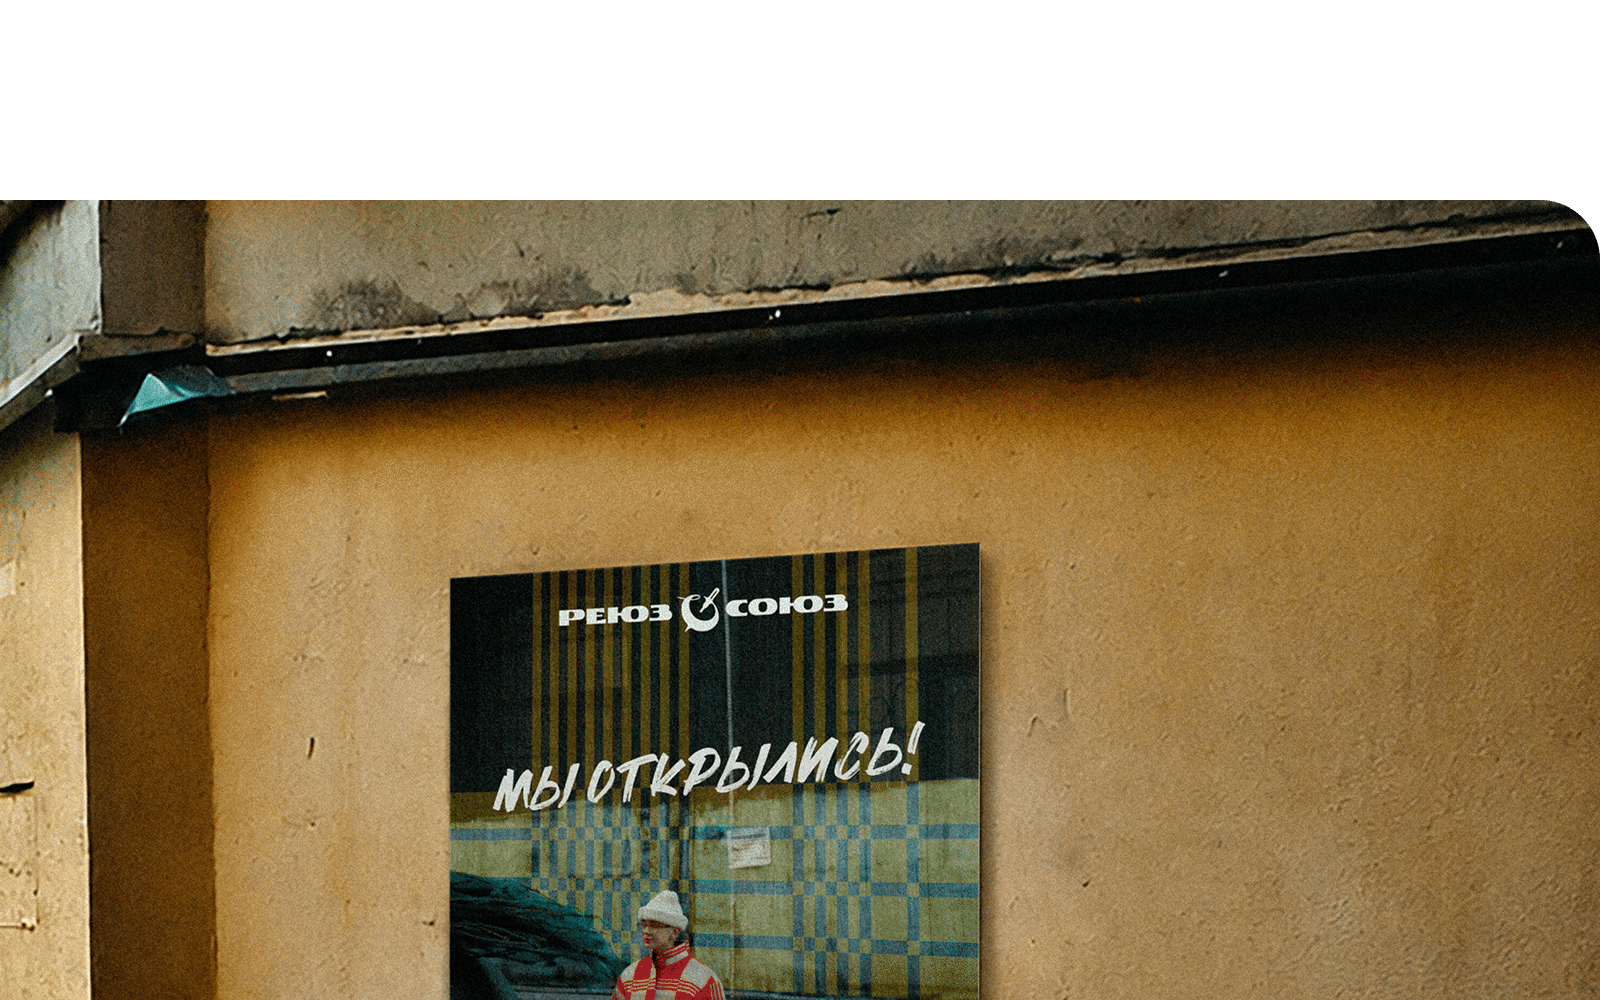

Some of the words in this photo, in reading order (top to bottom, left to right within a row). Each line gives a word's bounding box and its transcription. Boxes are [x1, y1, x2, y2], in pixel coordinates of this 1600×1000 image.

[558, 603, 673, 627] РЕЮЗ
[725, 593, 849, 617] СОЮЗ
[492, 763, 578, 812] МЫ
[586, 721, 926, 804] ОТКРЫЛИСЬ!
